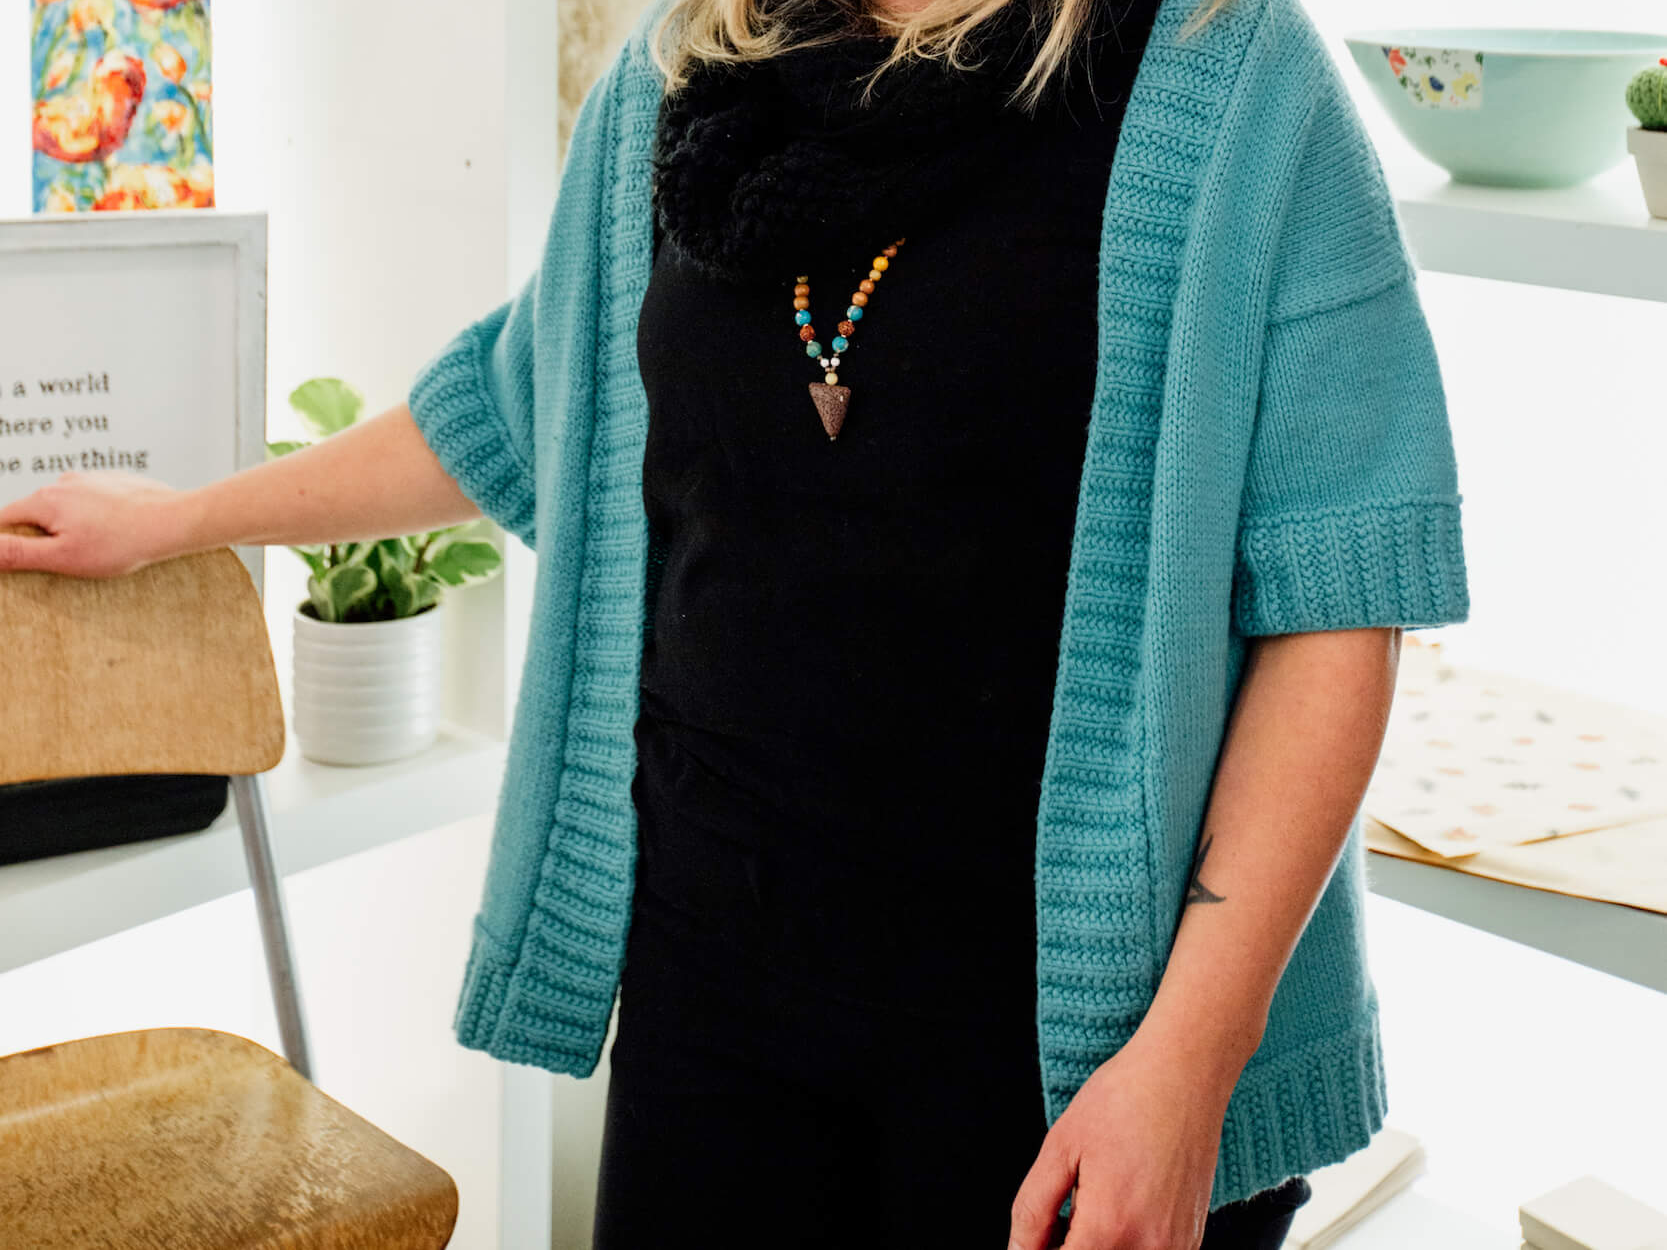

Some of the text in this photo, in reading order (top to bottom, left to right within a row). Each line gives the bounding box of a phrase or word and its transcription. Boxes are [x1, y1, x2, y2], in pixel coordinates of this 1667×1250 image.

[12, 381, 27, 397] a
[38, 372, 109, 394] world
[0, 415, 109, 438] here you
[32, 447, 148, 472] anything
